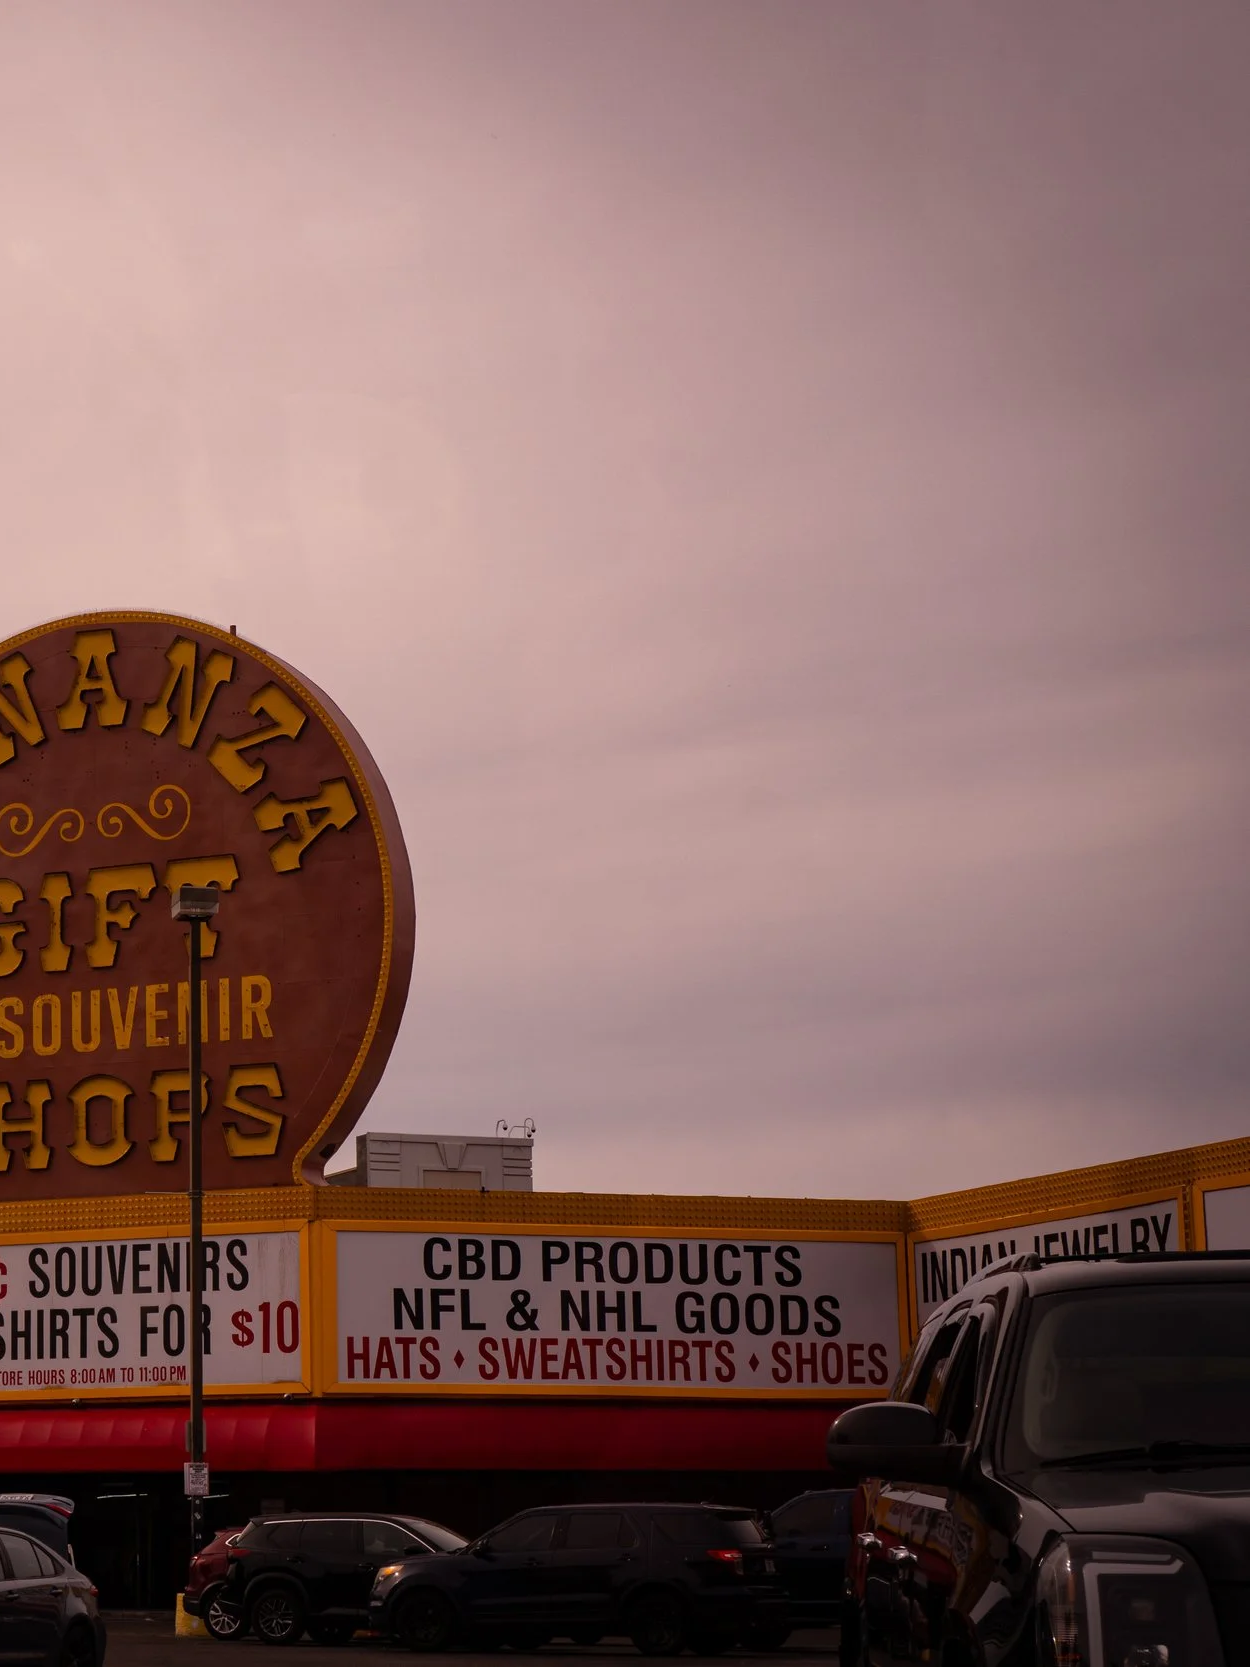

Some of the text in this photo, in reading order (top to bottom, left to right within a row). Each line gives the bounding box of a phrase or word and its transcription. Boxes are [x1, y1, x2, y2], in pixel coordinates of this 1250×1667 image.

[423, 1237, 802, 1287] CBD PRODUCTS
[140, 1304, 211, 1358] FOR
[231, 1300, 300, 1354] $10
[393, 1288, 841, 1338] NFL & NHL GOODS
[28, 1369, 65, 1385] HOURS
[120, 1367, 134, 1382] TO
[346, 1336, 888, 1385] HATS SWEATSHIRTS SHOES
